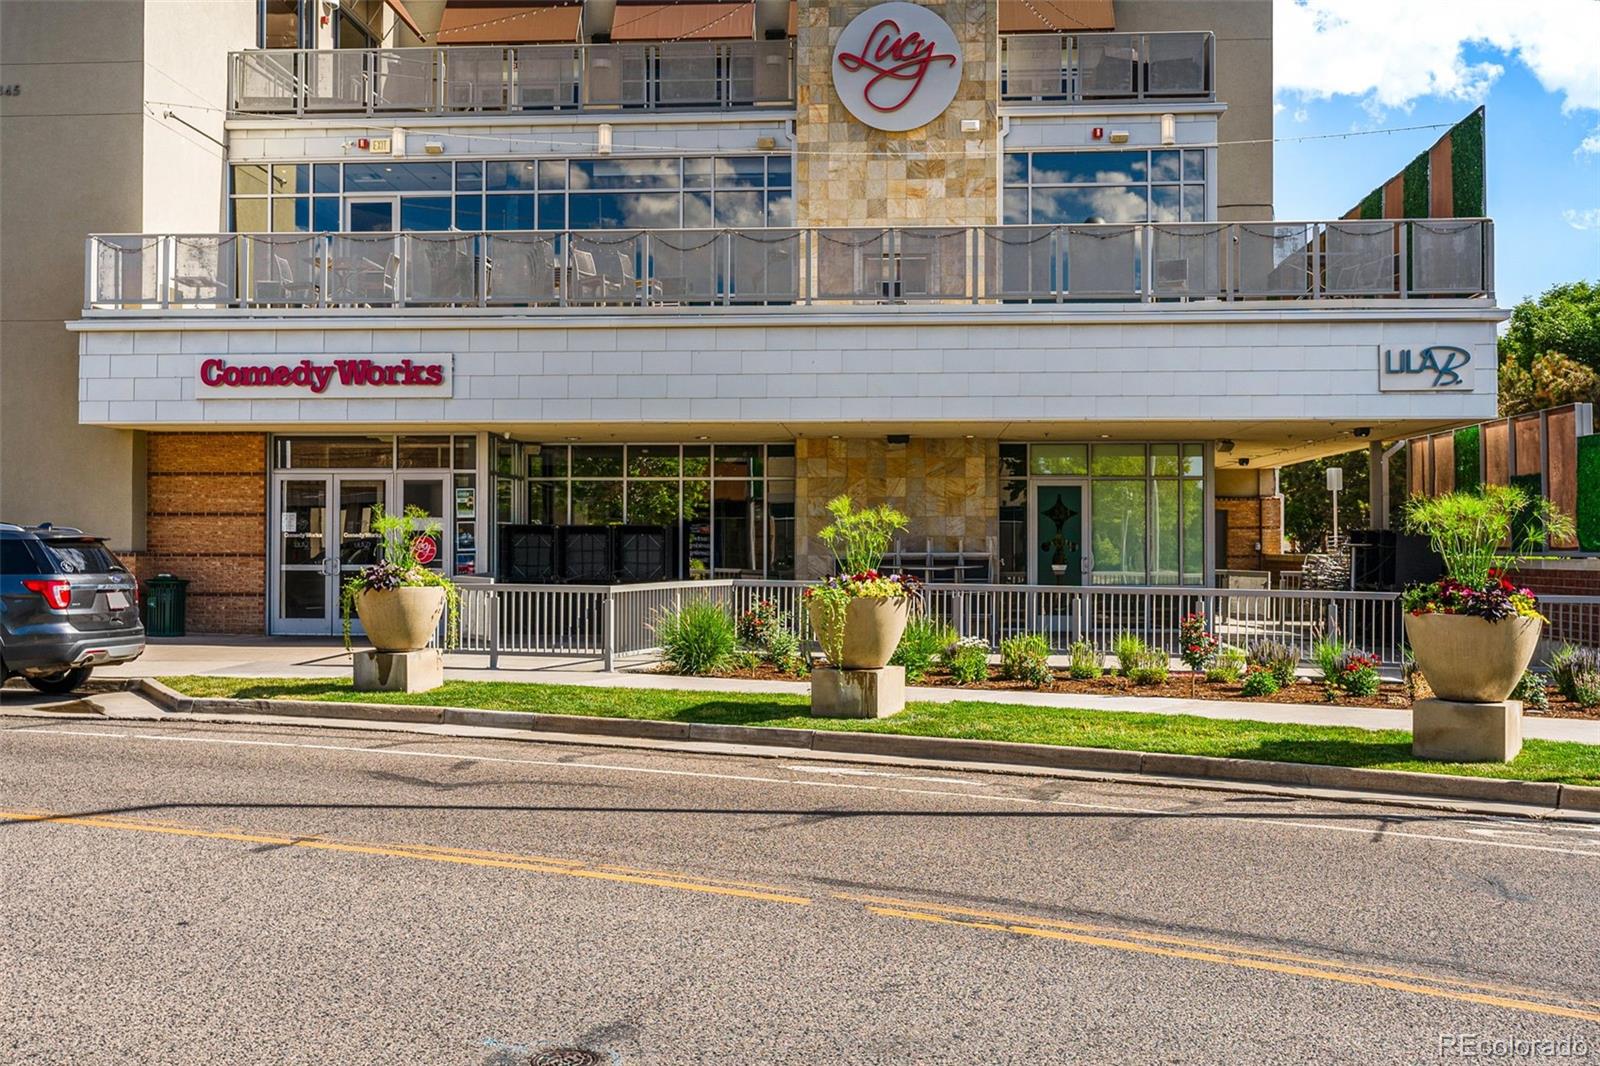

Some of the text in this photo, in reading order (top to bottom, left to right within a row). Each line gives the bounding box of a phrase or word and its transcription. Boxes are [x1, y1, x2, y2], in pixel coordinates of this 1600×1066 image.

[838, 19, 957, 113] Lucy
[372, 140, 388, 151] EXIT
[200, 358, 443, 393] Comedy Works
[1385, 349, 1439, 374] LILA
